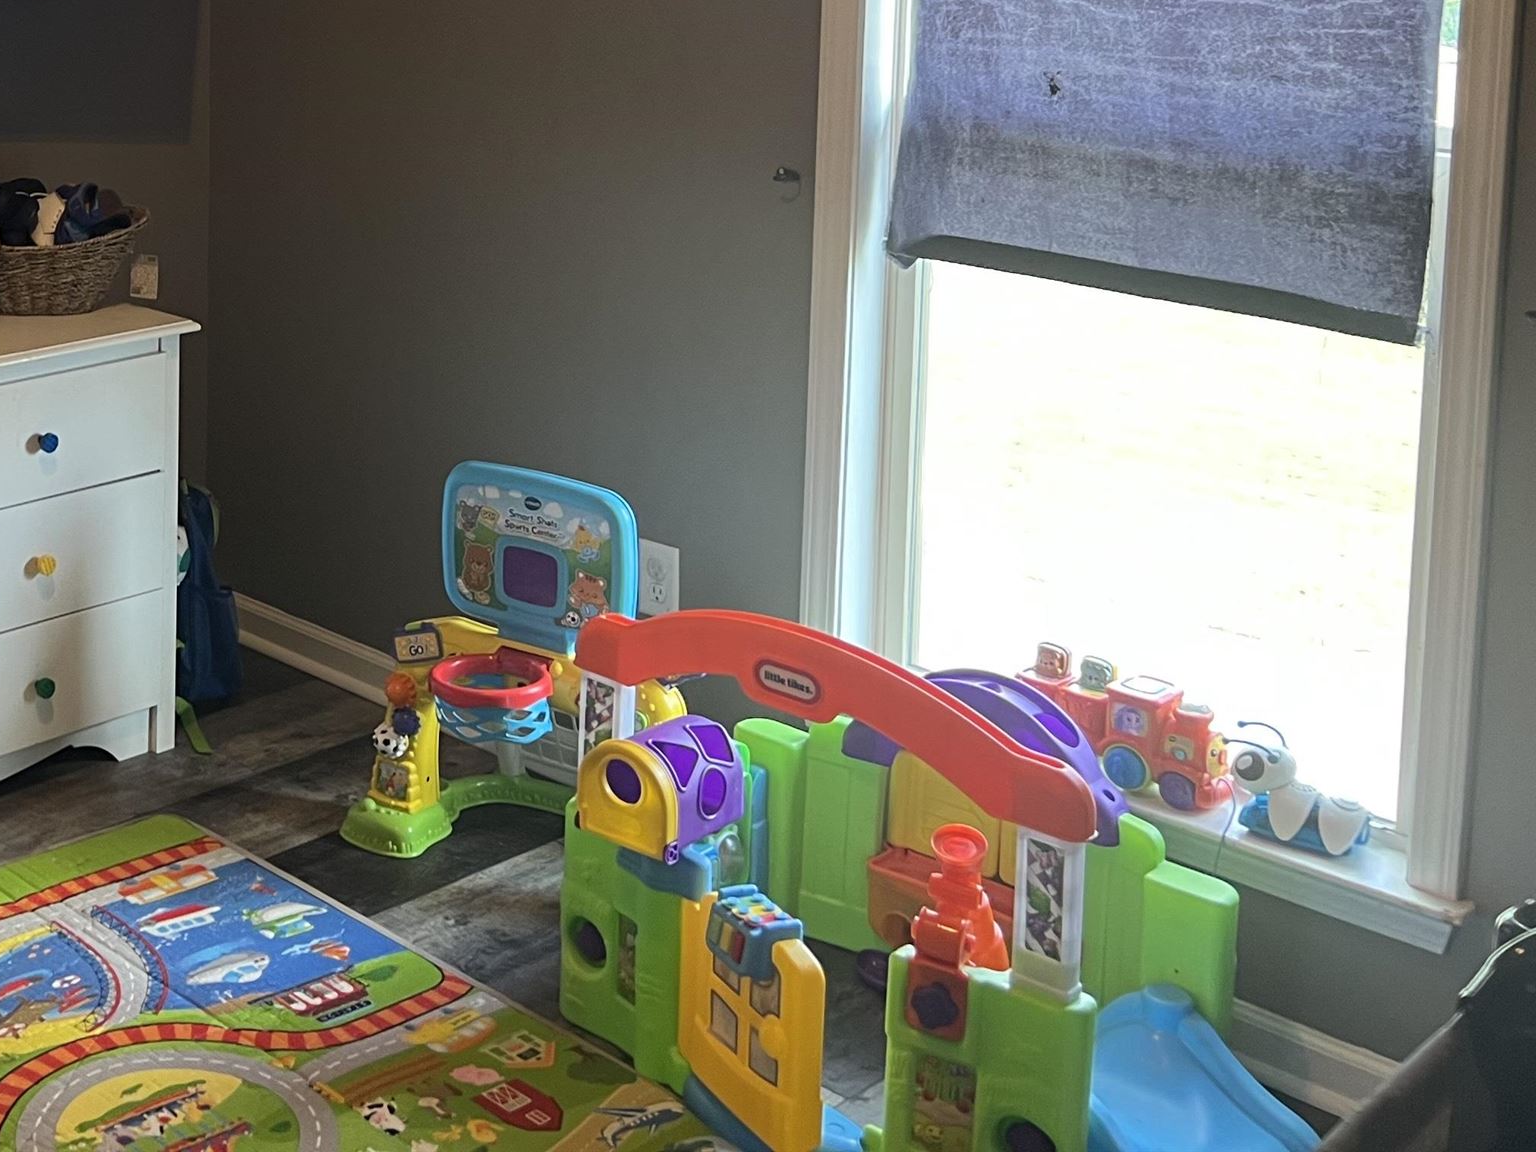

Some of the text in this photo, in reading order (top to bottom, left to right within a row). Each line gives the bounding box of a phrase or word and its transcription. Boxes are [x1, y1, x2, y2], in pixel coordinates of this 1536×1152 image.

[509, 508, 533, 521] Smart
[504, 519, 529, 532] Sports
[764, 670, 785, 685] little
